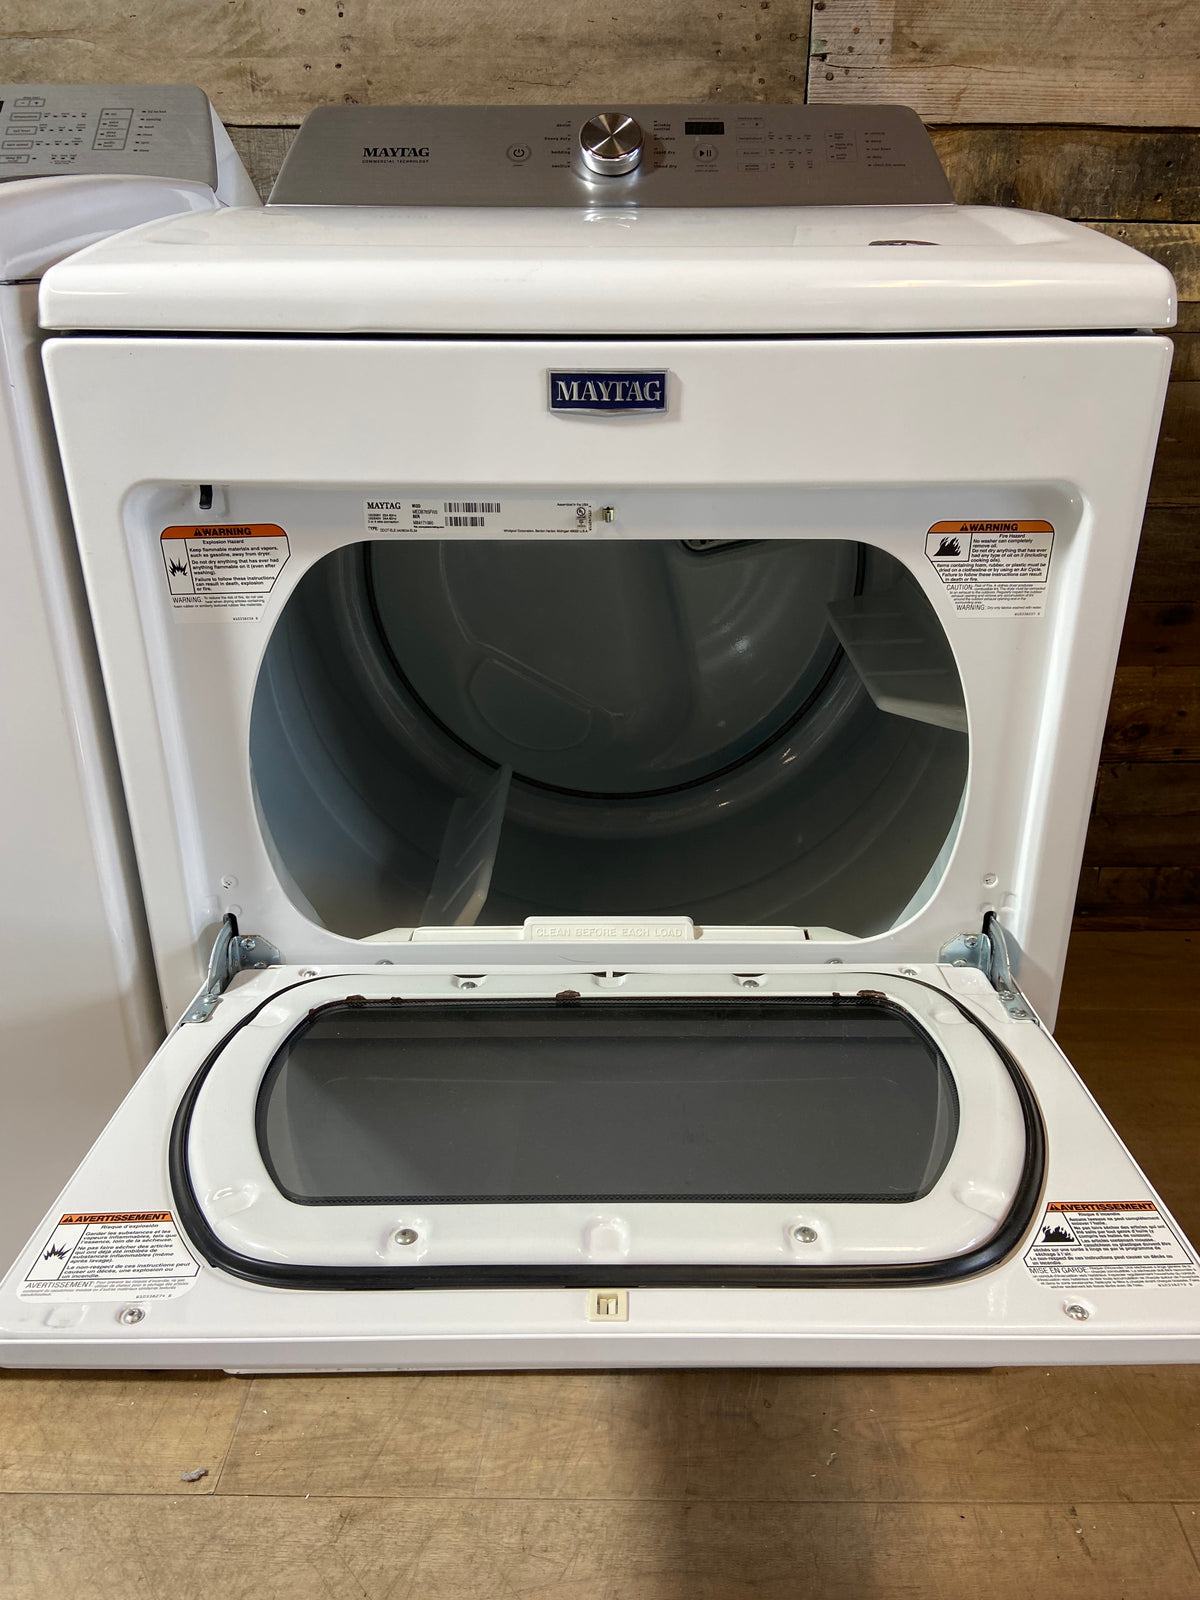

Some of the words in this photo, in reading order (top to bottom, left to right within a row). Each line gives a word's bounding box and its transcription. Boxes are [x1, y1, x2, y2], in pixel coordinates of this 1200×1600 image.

[363, 147, 430, 157] MAYTAG
[556, 380, 662, 401] MAYTAG
[203, 528, 252, 536] WARNING
[536, 928, 570, 937] CLEAN
[575, 928, 617, 937] BEFORE
[622, 928, 649, 937] EACH
[655, 928, 682, 937] LOAD
[74, 1213, 169, 1222] AVERTISSEMENT
